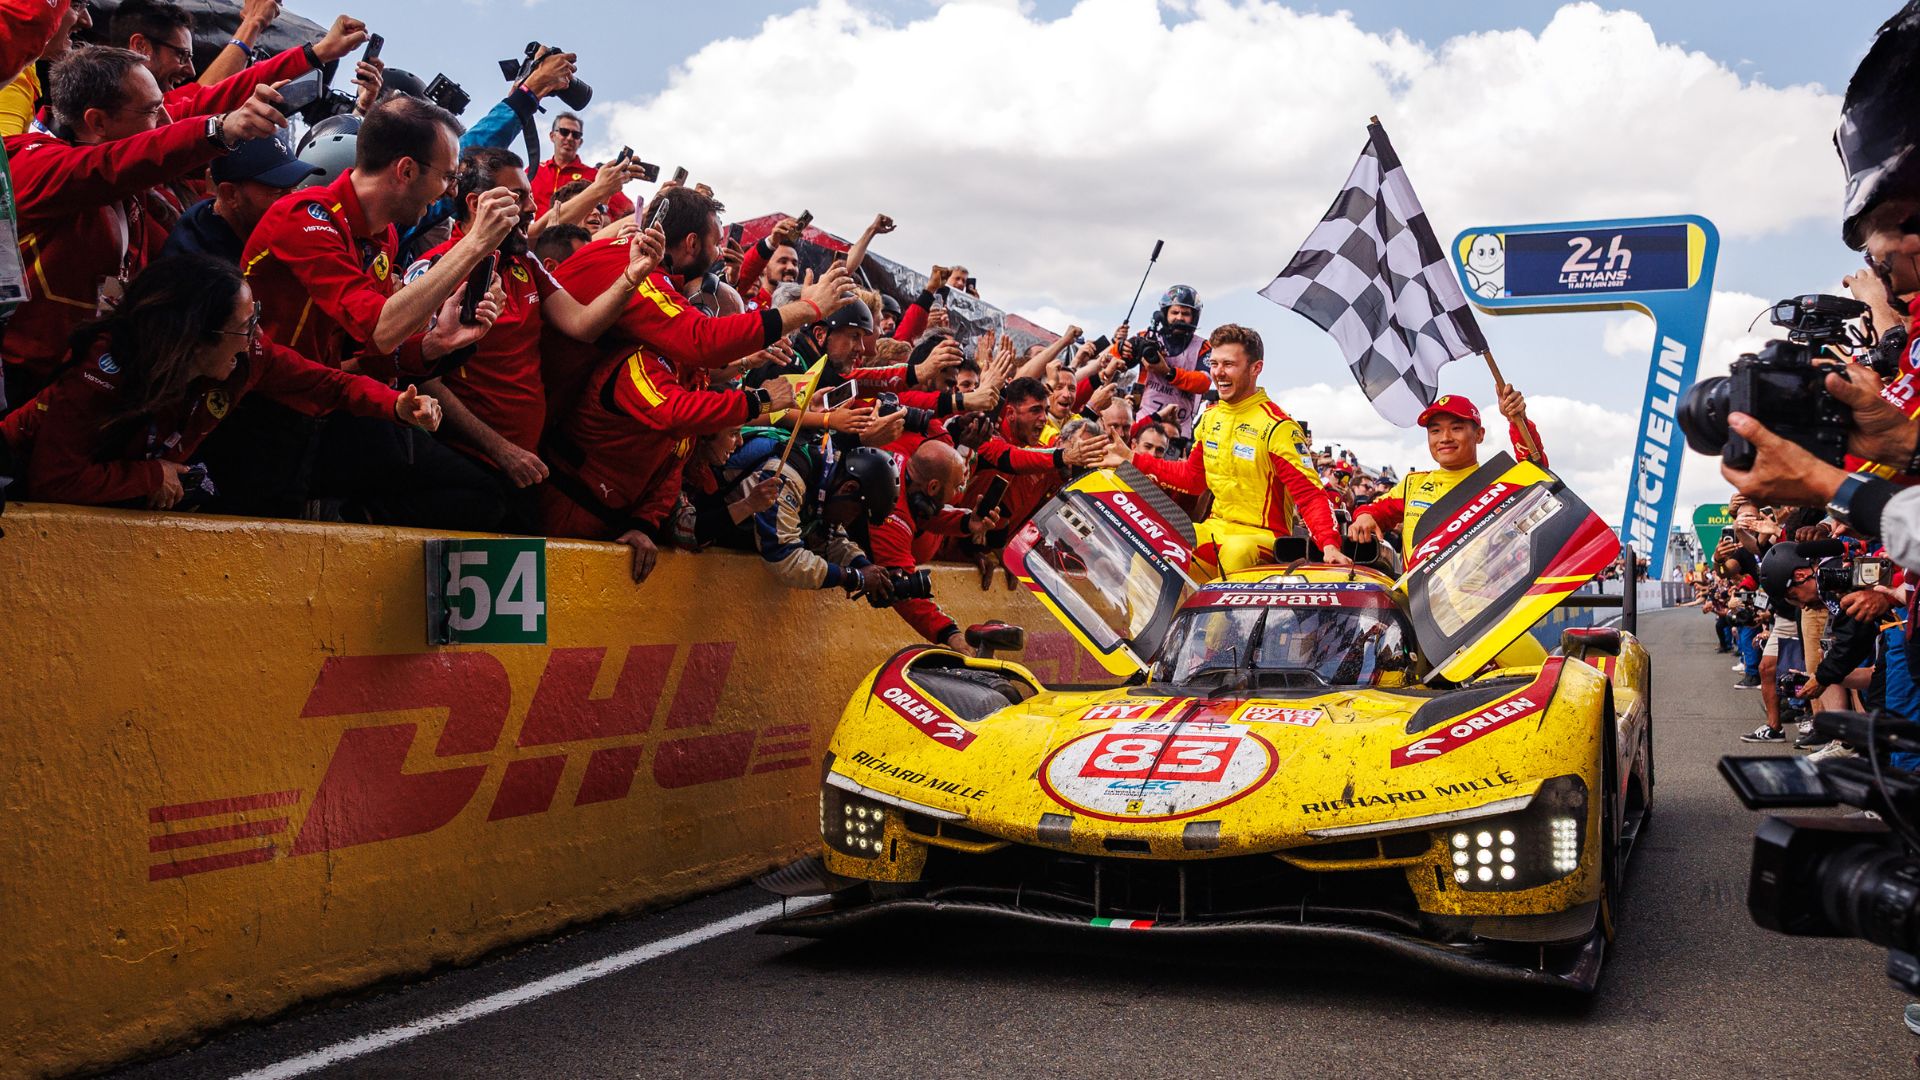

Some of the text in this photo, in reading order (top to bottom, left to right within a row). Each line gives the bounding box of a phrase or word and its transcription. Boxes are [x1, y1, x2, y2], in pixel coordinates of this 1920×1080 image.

[1561, 235, 1632, 272] 24h
[1558, 273, 1578, 283] LE
[1592, 281, 1607, 289] JUIN
[1628, 336, 1687, 564] MICHELIN
[1112, 493, 1163, 539] ORLEN
[1446, 483, 1508, 532] ORLEN
[1429, 544, 1458, 569] R.KUBICA
[1463, 513, 1495, 540] P.HANSON
[446, 551, 544, 631] 54
[1202, 583, 1278, 591] CHARLES
[1211, 592, 1342, 606] Ferrari
[883, 687, 940, 724] ORLEN
[1085, 705, 1146, 720] HY
[1244, 712, 1311, 725] CAR
[1249, 706, 1318, 717] HYPER
[1450, 697, 1536, 738] ORLEN
[288, 641, 756, 857] DHL
[1094, 738, 1229, 774] 83
[851, 750, 989, 801] RICHARD MILLE
[1108, 780, 1182, 791] WEC
[1301, 770, 1519, 815] RICHARD MILLE
